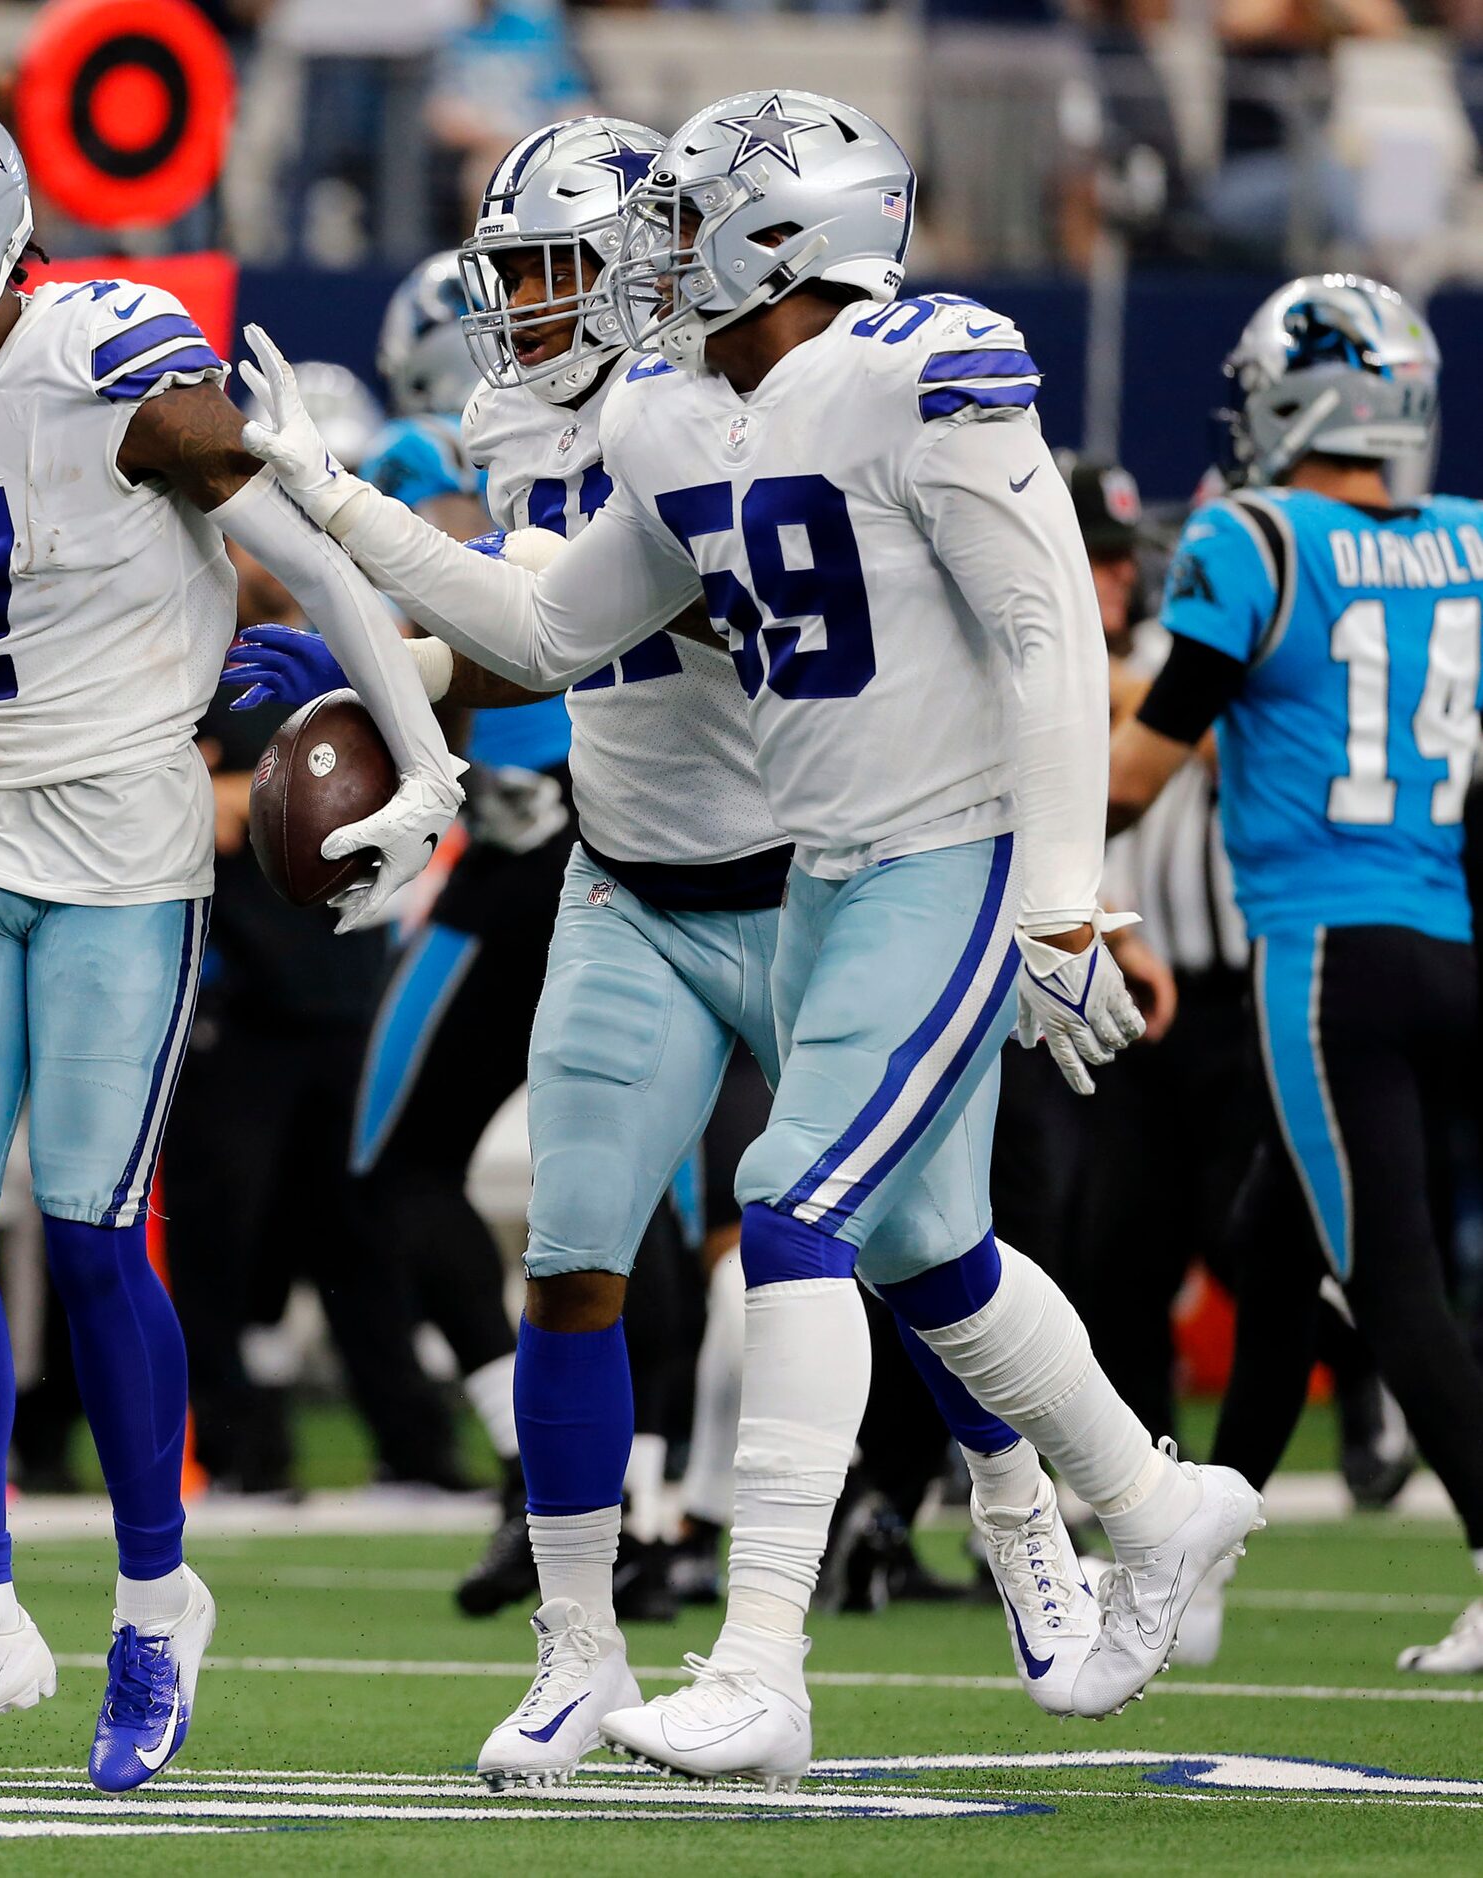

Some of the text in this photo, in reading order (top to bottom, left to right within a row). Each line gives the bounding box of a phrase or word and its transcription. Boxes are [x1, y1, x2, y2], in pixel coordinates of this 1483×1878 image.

[654, 474, 877, 700] 59
[321, 752, 335, 769] 223
[1327, 597, 1483, 825] 14
